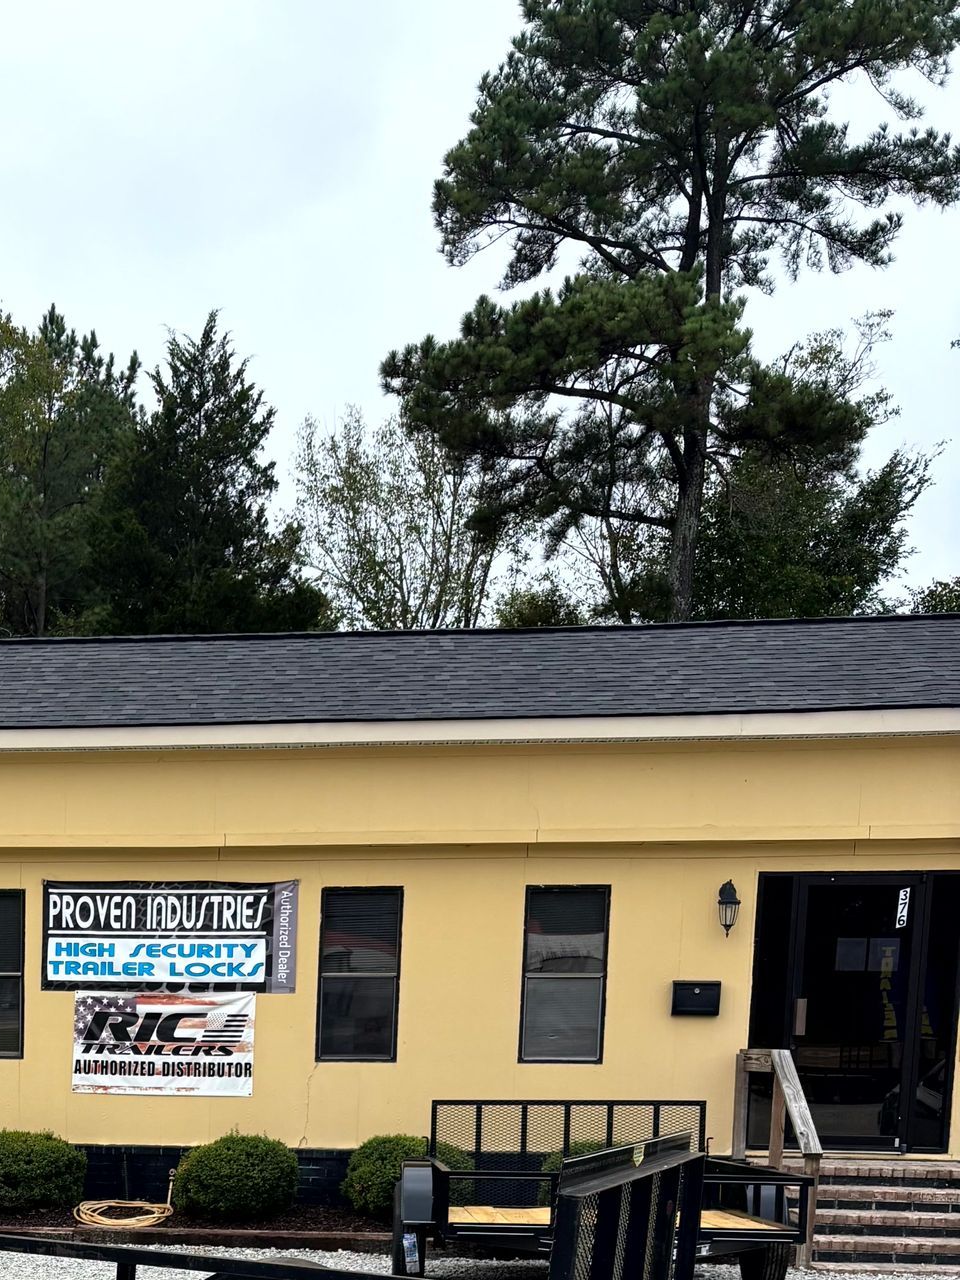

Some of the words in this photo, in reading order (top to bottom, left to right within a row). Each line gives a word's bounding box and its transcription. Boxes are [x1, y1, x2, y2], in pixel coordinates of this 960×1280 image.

[48, 894, 135, 929] PROVEN
[147, 894, 268, 930] INDUSTRIES
[279, 890, 292, 949] Authorized
[897, 890, 909, 925] 376
[55, 942, 115, 957] HIGH
[129, 942, 258, 959] SECURITY
[49, 960, 155, 976] TRAILER
[169, 961, 265, 977] LOCKS
[277, 950, 291, 984] Dealer
[81, 1043, 237, 1057] TRAILERS
[74, 1061, 155, 1077] AUTHORIZED
[161, 1062, 252, 1078] DISTRIBUTOR
